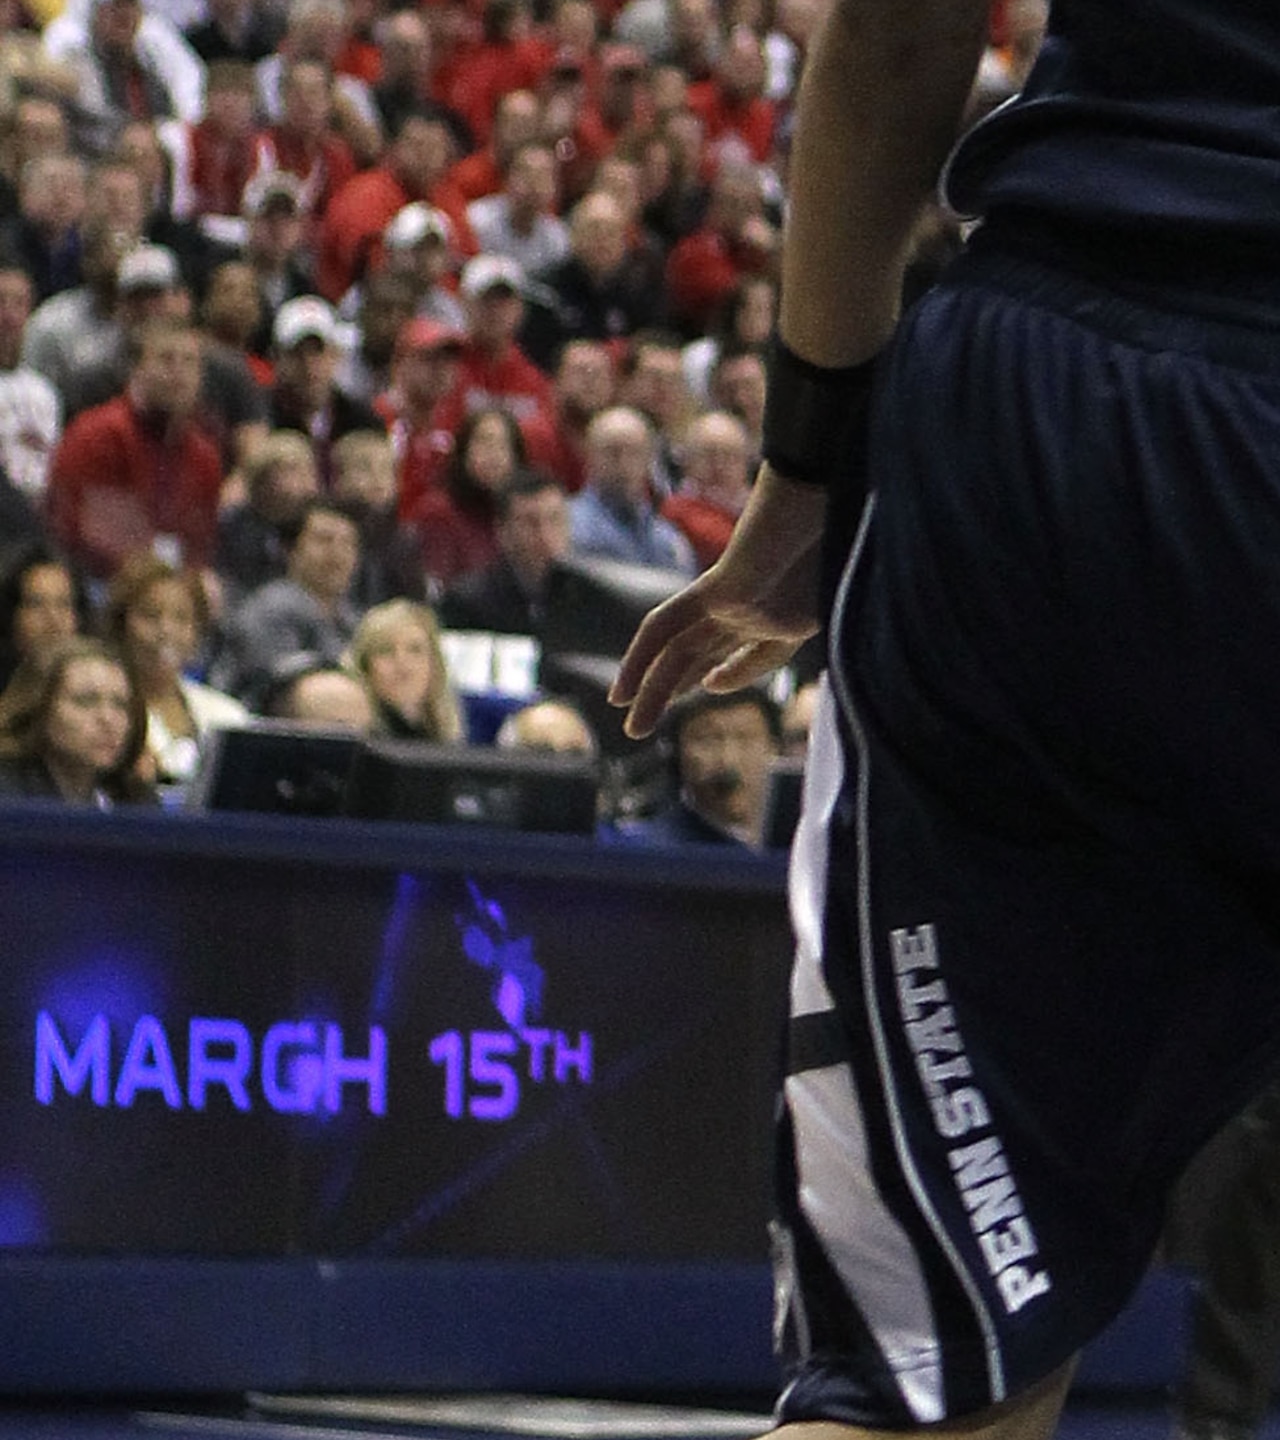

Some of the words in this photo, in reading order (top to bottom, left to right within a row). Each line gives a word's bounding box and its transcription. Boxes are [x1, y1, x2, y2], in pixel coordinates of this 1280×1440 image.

[32, 1009, 391, 1118] MARCH
[888, 922, 993, 1140] STATE
[948, 1135, 1053, 1315] PENN
